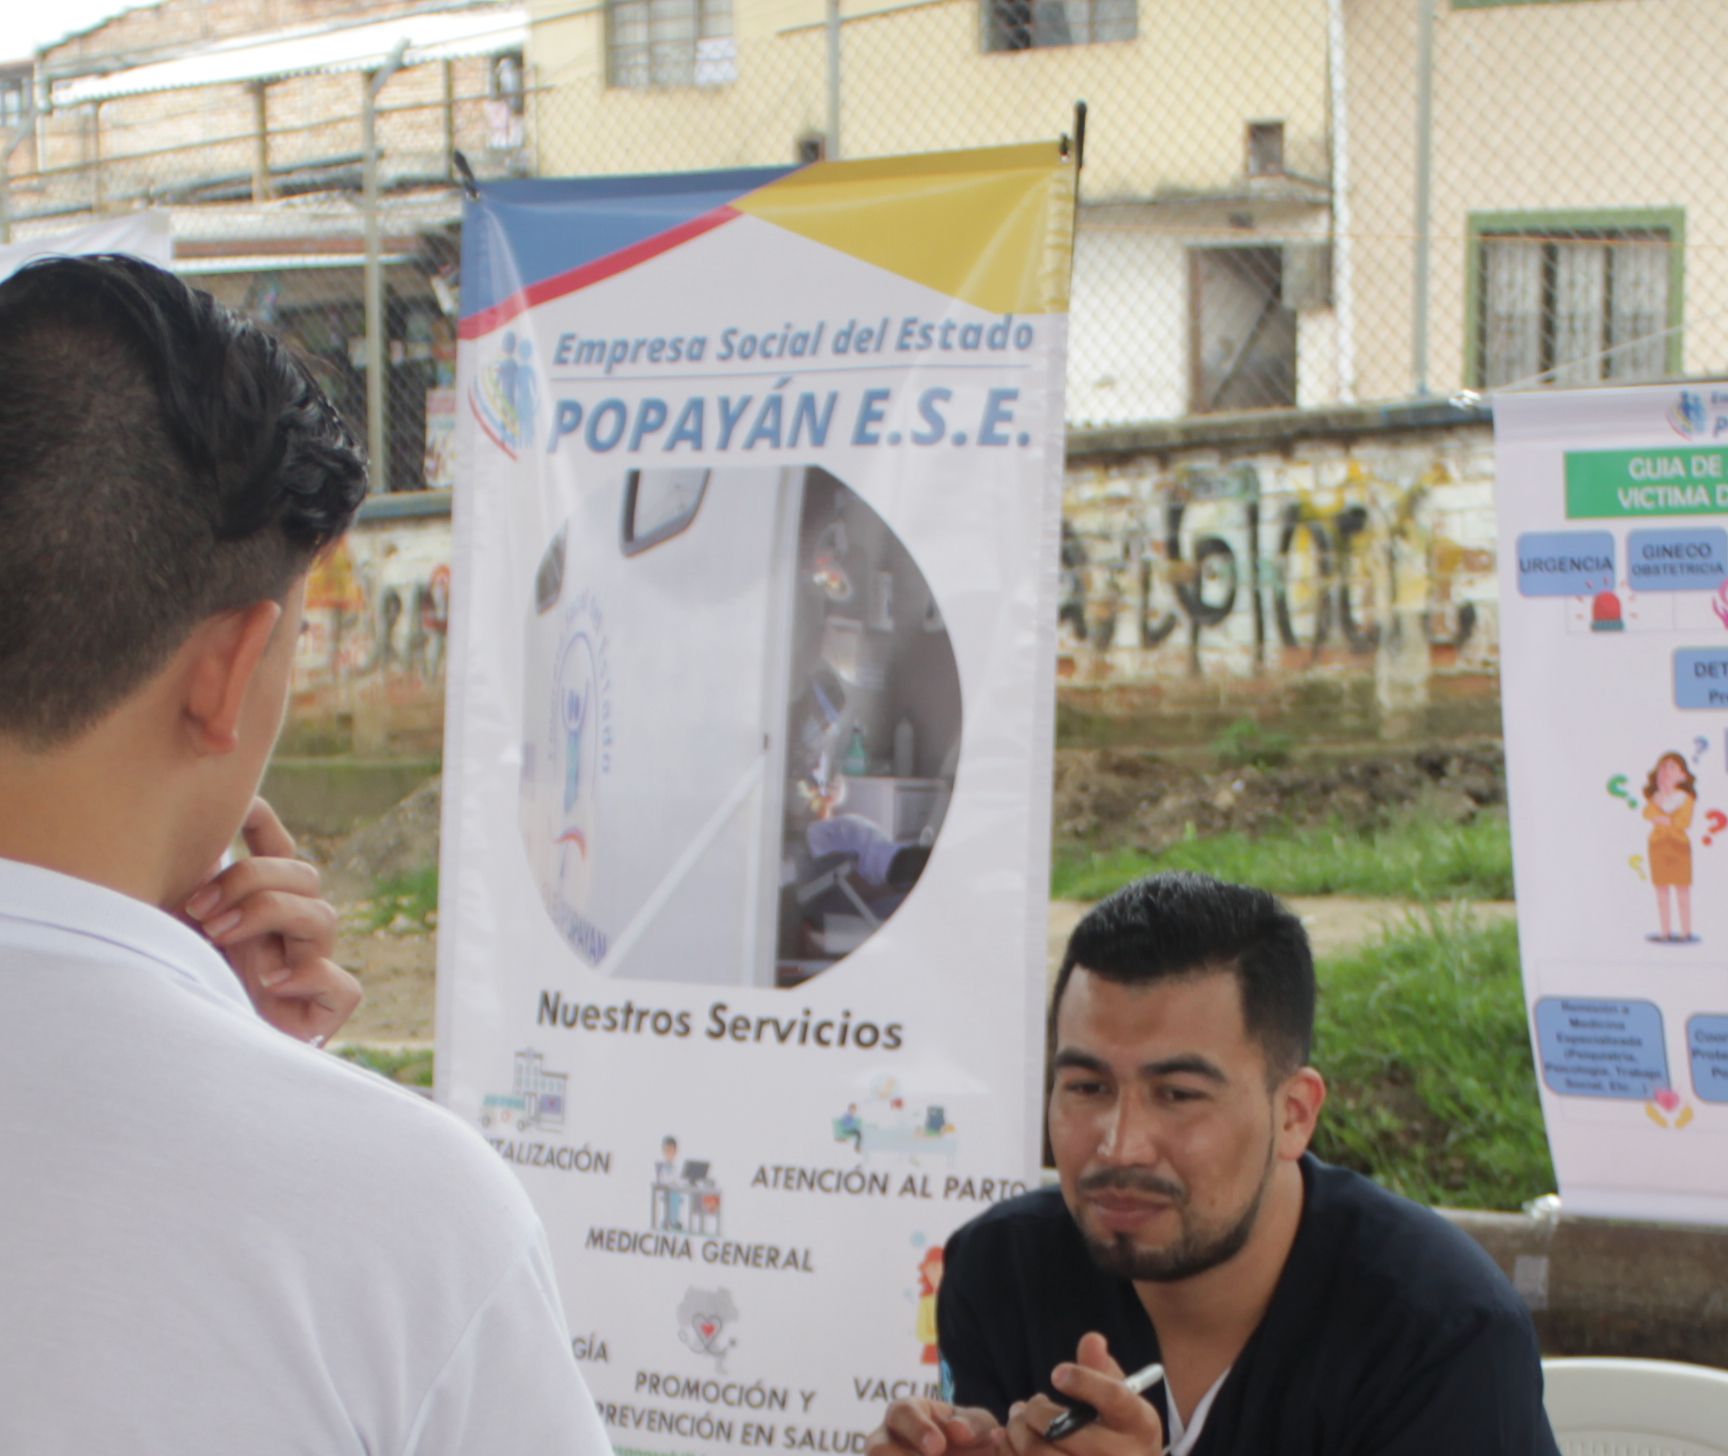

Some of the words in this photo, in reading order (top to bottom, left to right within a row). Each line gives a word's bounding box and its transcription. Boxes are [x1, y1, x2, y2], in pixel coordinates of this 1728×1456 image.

[553, 331, 706, 374] Empresa
[716, 321, 822, 361] Social
[832, 317, 884, 354] del
[896, 314, 1034, 352] Estado
[546, 377, 838, 454] POPAYÁN
[850, 386, 1031, 448] E.S.E.
[1692, 455, 1721, 476] DE
[1618, 486, 1710, 509] VICTIMA
[1519, 558, 1613, 574] URGENCIA
[1642, 543, 1712, 558] GINECO
[1632, 563, 1724, 576] OBSTETRICIA
[538, 991, 692, 1037] Nuestros
[706, 1002, 903, 1051] Servicios
[490, 1139, 613, 1174] TALIZACIÓN
[751, 1163, 888, 1197] ATENCIÓN
[898, 1171, 930, 1199] AL
[945, 1176, 1026, 1202] PARTO
[585, 1227, 693, 1262] MEDICINA
[701, 1240, 814, 1273] GENERAL
[635, 1370, 788, 1412] PROMOCIÓN
[800, 1390, 817, 1413] Y
[741, 1423, 773, 1447] EN
[783, 1427, 866, 1455] SALUD
